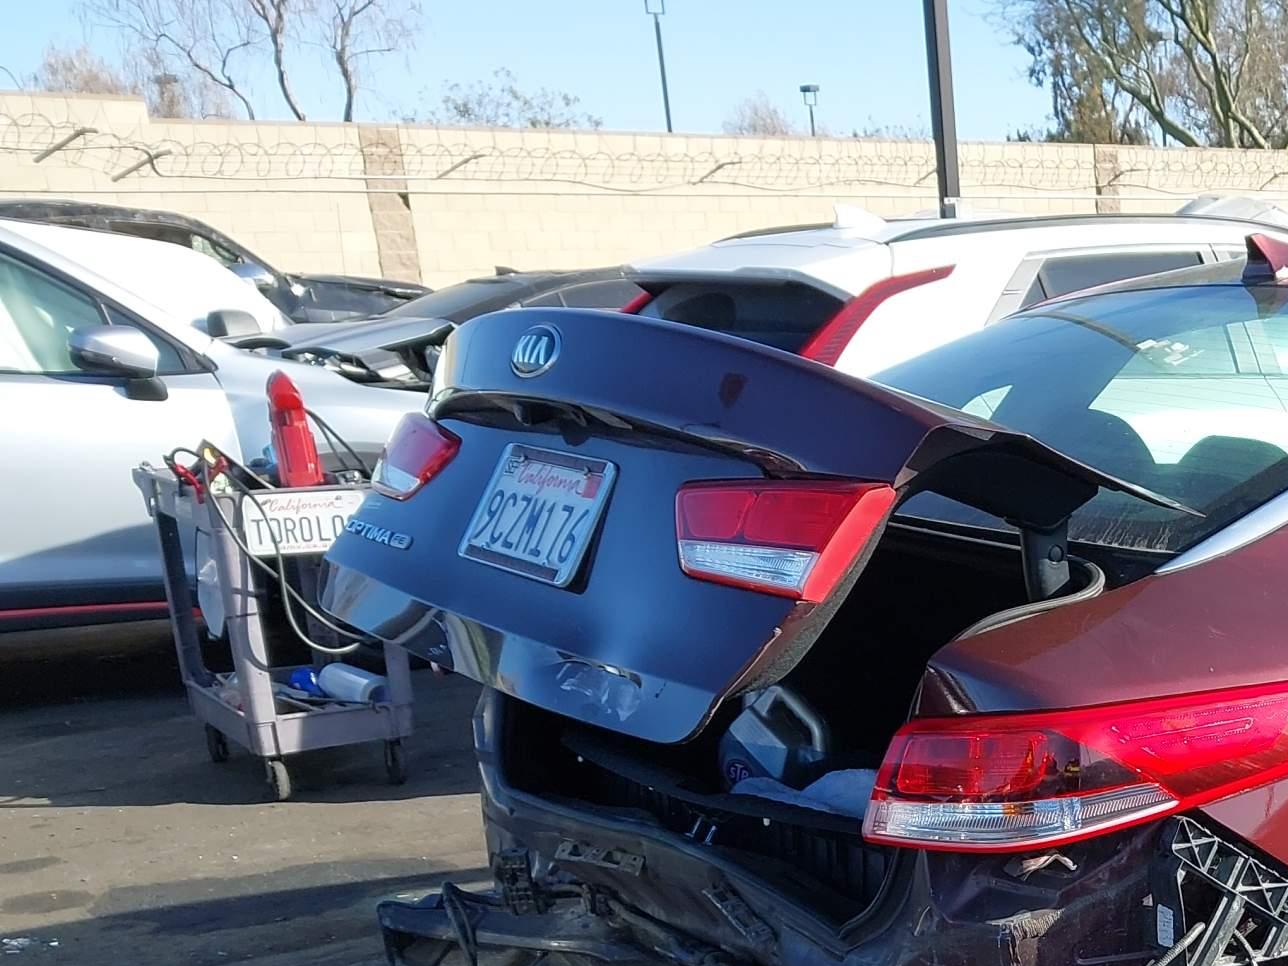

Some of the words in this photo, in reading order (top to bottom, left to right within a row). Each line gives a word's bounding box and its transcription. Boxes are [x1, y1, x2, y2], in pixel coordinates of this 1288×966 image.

[513, 335, 549, 365] KIA
[517, 463, 583, 495] California
[268, 499, 338, 514] California
[346, 519, 391, 546] OPTIMA
[472, 489, 590, 563] 9CZM176
[729, 763, 749, 781] STP
